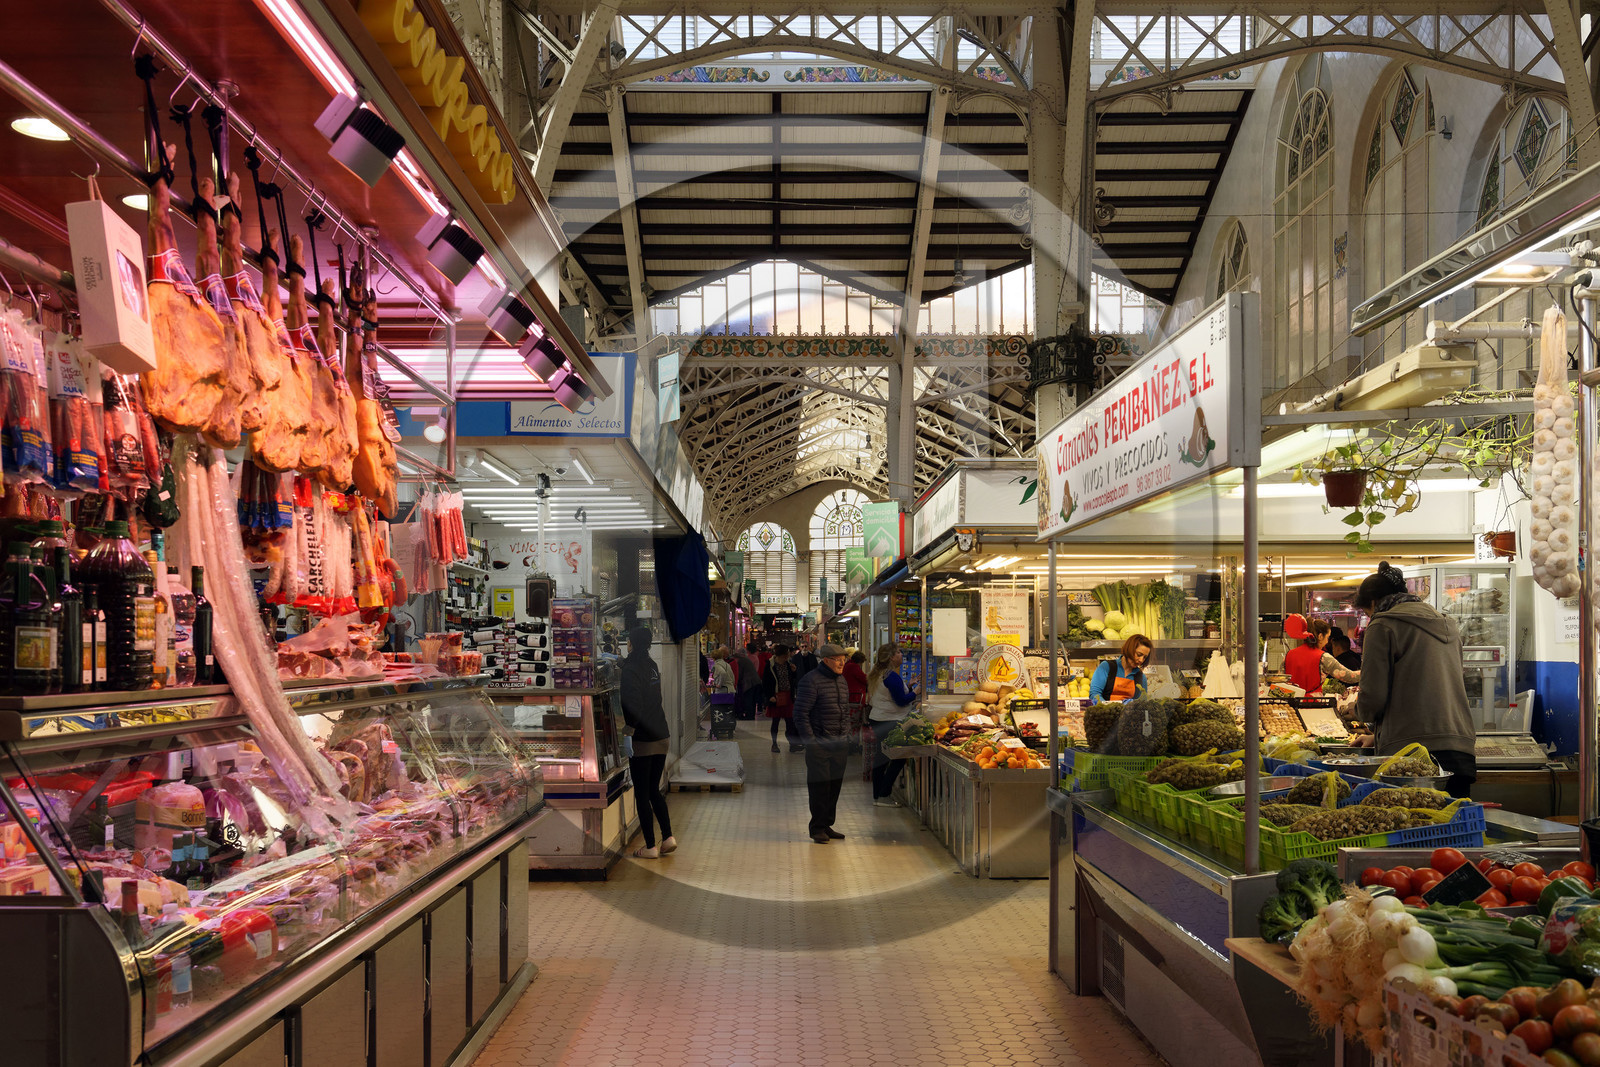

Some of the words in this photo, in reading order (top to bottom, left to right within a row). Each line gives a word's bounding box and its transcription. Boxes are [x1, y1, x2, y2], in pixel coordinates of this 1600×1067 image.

[513, 414, 572, 429] Alimentos
[577, 415, 621, 429] Selectos
[1056, 419, 1099, 475] Caracoles
[1189, 351, 1214, 398] S.L.
[1082, 465, 1104, 495] VIVOS
[1105, 460, 1111, 483] Y
[1114, 431, 1169, 479] PRECOCIDOS
[1136, 476, 1144, 493] 96
[1144, 471, 1154, 490] 367
[1154, 467, 1163, 486] 33
[1163, 463, 1172, 483] 02
[864, 508, 891, 516] Servicio
[303, 513, 318, 594] CARCHELEJO
[509, 541, 566, 554] VINOECA
